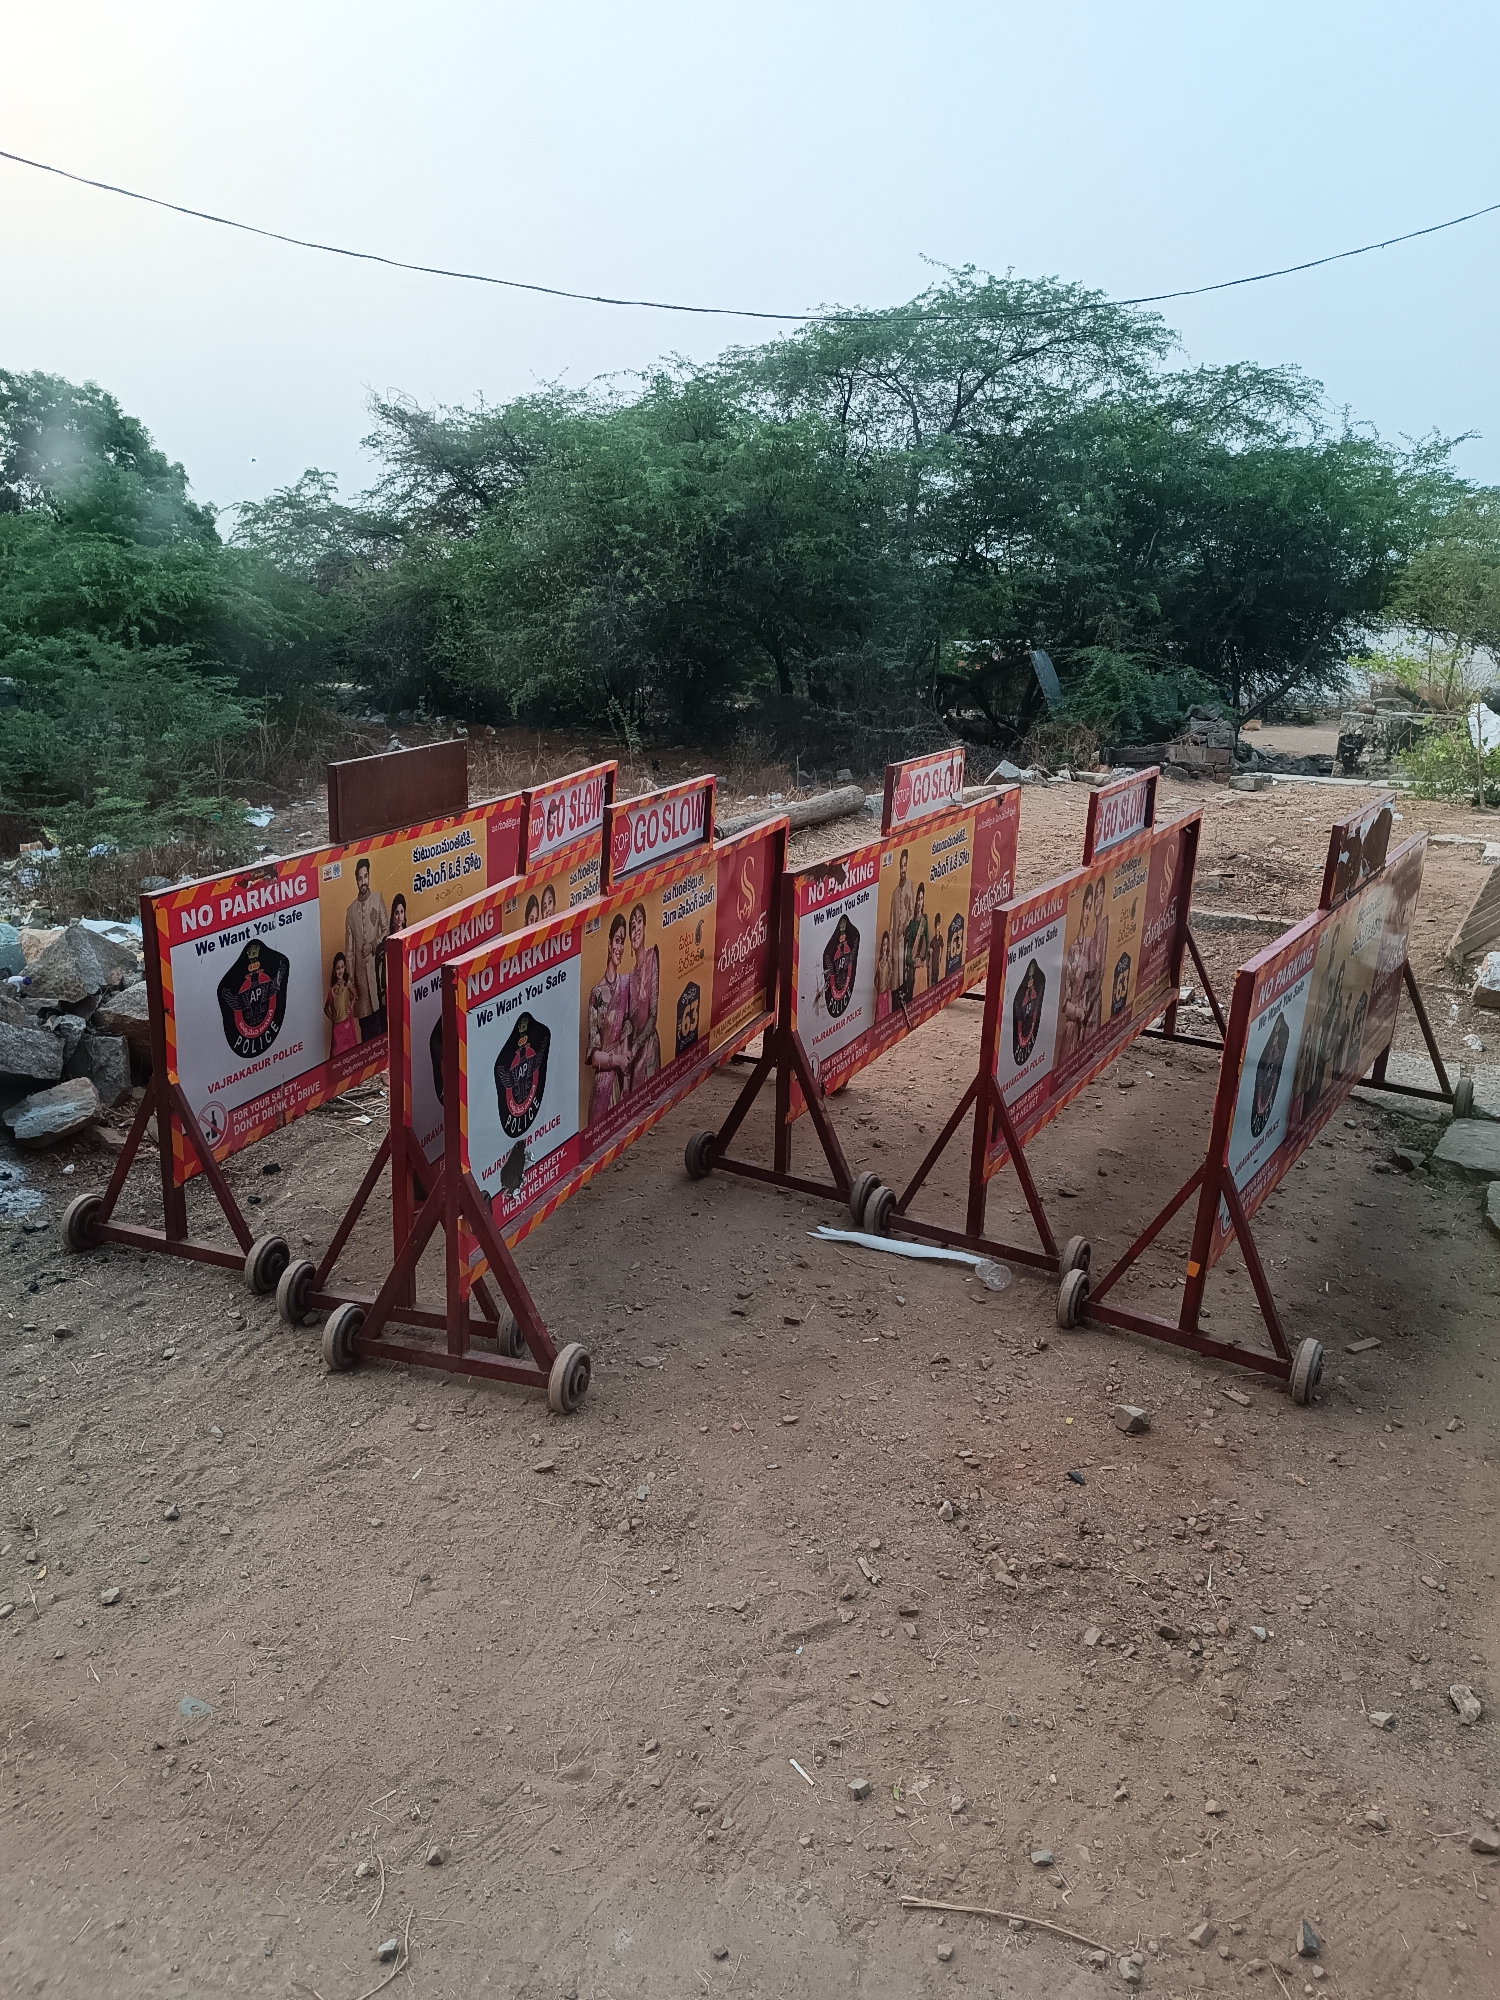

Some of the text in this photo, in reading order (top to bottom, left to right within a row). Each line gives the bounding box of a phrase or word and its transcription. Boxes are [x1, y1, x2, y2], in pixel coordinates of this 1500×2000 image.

[913, 761, 963, 807] GO SLOW
[531, 817, 544, 836] TOP
[545, 776, 605, 842] GO SLOW
[634, 791, 707, 855] GO SLOW
[1103, 786, 1146, 841] GO SLOW
[181, 875, 307, 933] NO PARKING
[808, 879, 824, 905] NO
[813, 890, 870, 926] We Want You Safe
[195, 909, 303, 956] We Want You Safe
[433, 909, 494, 960] PARKING
[1022, 897, 1064, 931] PARKING
[467, 930, 573, 1000] NO PARKING
[1007, 950, 1017, 966] We
[1018, 941, 1033, 959] Want
[1034, 935, 1045, 949] You
[1045, 926, 1058, 942] Safe
[250, 988, 262, 1003] AP
[414, 985, 428, 1003] We
[1257, 943, 1315, 1008] NO PARKING
[476, 970, 567, 1028] We Want You Safe
[846, 1006, 863, 1024] POLICE
[234, 1020, 279, 1054] POLICE
[207, 1058, 272, 1095] VAJRAKARUR
[273, 1041, 304, 1064] POLICE
[518, 1063, 528, 1080] AP
[233, 1109, 248, 1123] FOR
[250, 1097, 270, 1115] YOUR
[234, 1081, 321, 1136] DON'T DRINK & DRIVE
[505, 1097, 540, 1134] POLICE
[534, 1115, 561, 1142] POLICE
[502, 1190, 527, 1217] WEAR
[528, 1164, 560, 1197] HELMET
